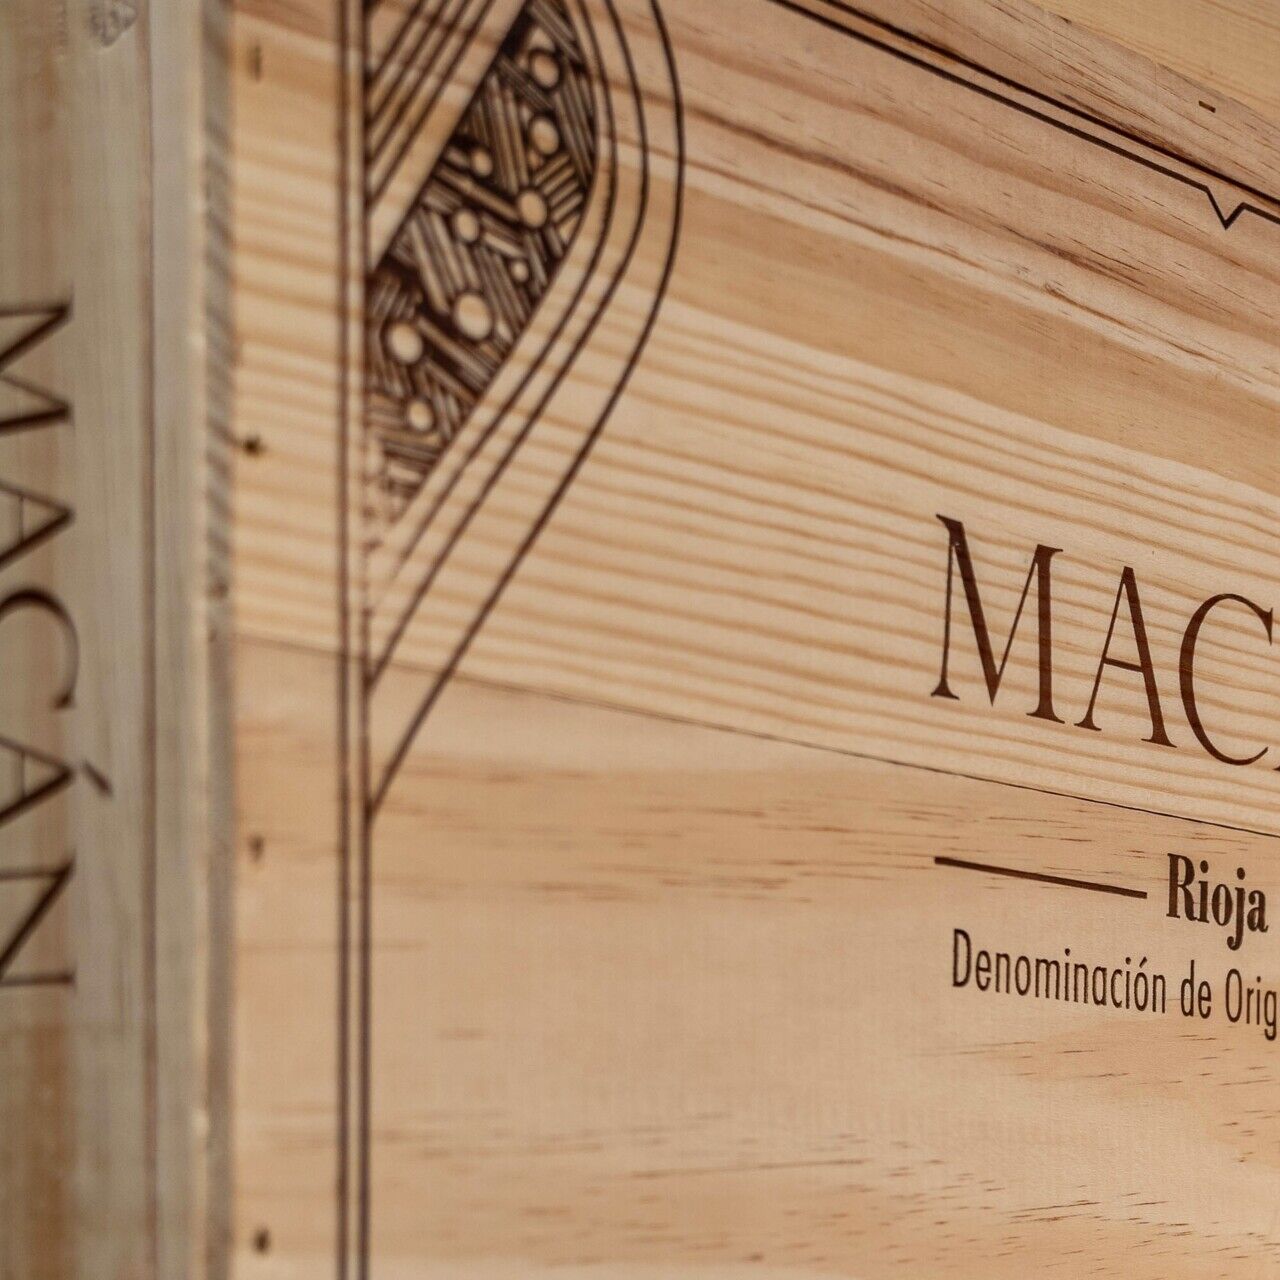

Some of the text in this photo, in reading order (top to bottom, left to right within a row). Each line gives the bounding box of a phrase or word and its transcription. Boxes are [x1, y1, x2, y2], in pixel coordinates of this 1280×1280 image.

[0, 292, 112, 990] MACÁN
[1165, 852, 1269, 951] Rioja
[952, 927, 1167, 1015] Denominación
[1180, 959, 1212, 1020] de
